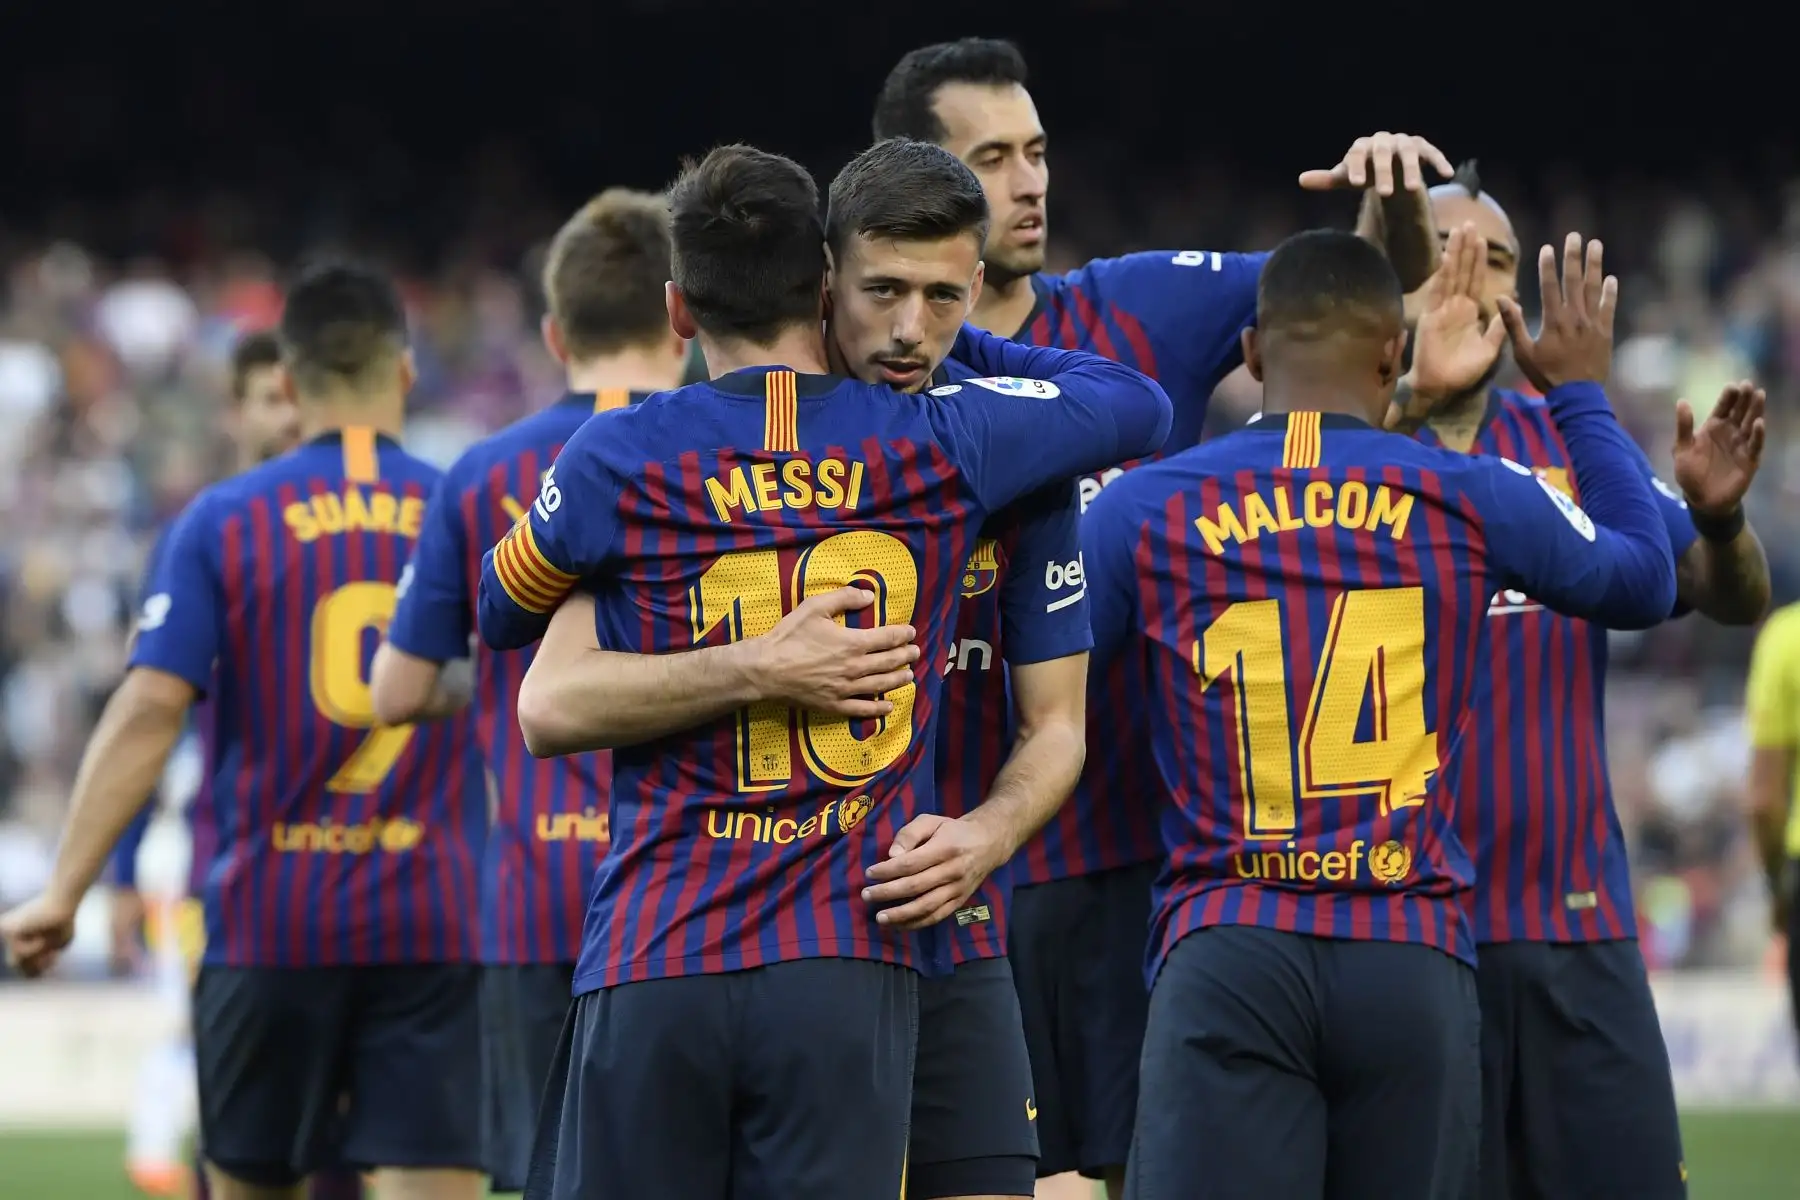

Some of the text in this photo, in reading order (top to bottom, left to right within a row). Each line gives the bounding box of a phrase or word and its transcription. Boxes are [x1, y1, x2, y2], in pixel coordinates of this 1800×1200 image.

[705, 459, 864, 523] MESSI
[1194, 481, 1415, 556] MALCOM
[309, 581, 417, 794] 9
[689, 530, 918, 792] 10
[1192, 586, 1440, 840] 14
[272, 815, 382, 854] unicef
[707, 801, 834, 844] unicef
[1235, 840, 1365, 881] unicef
